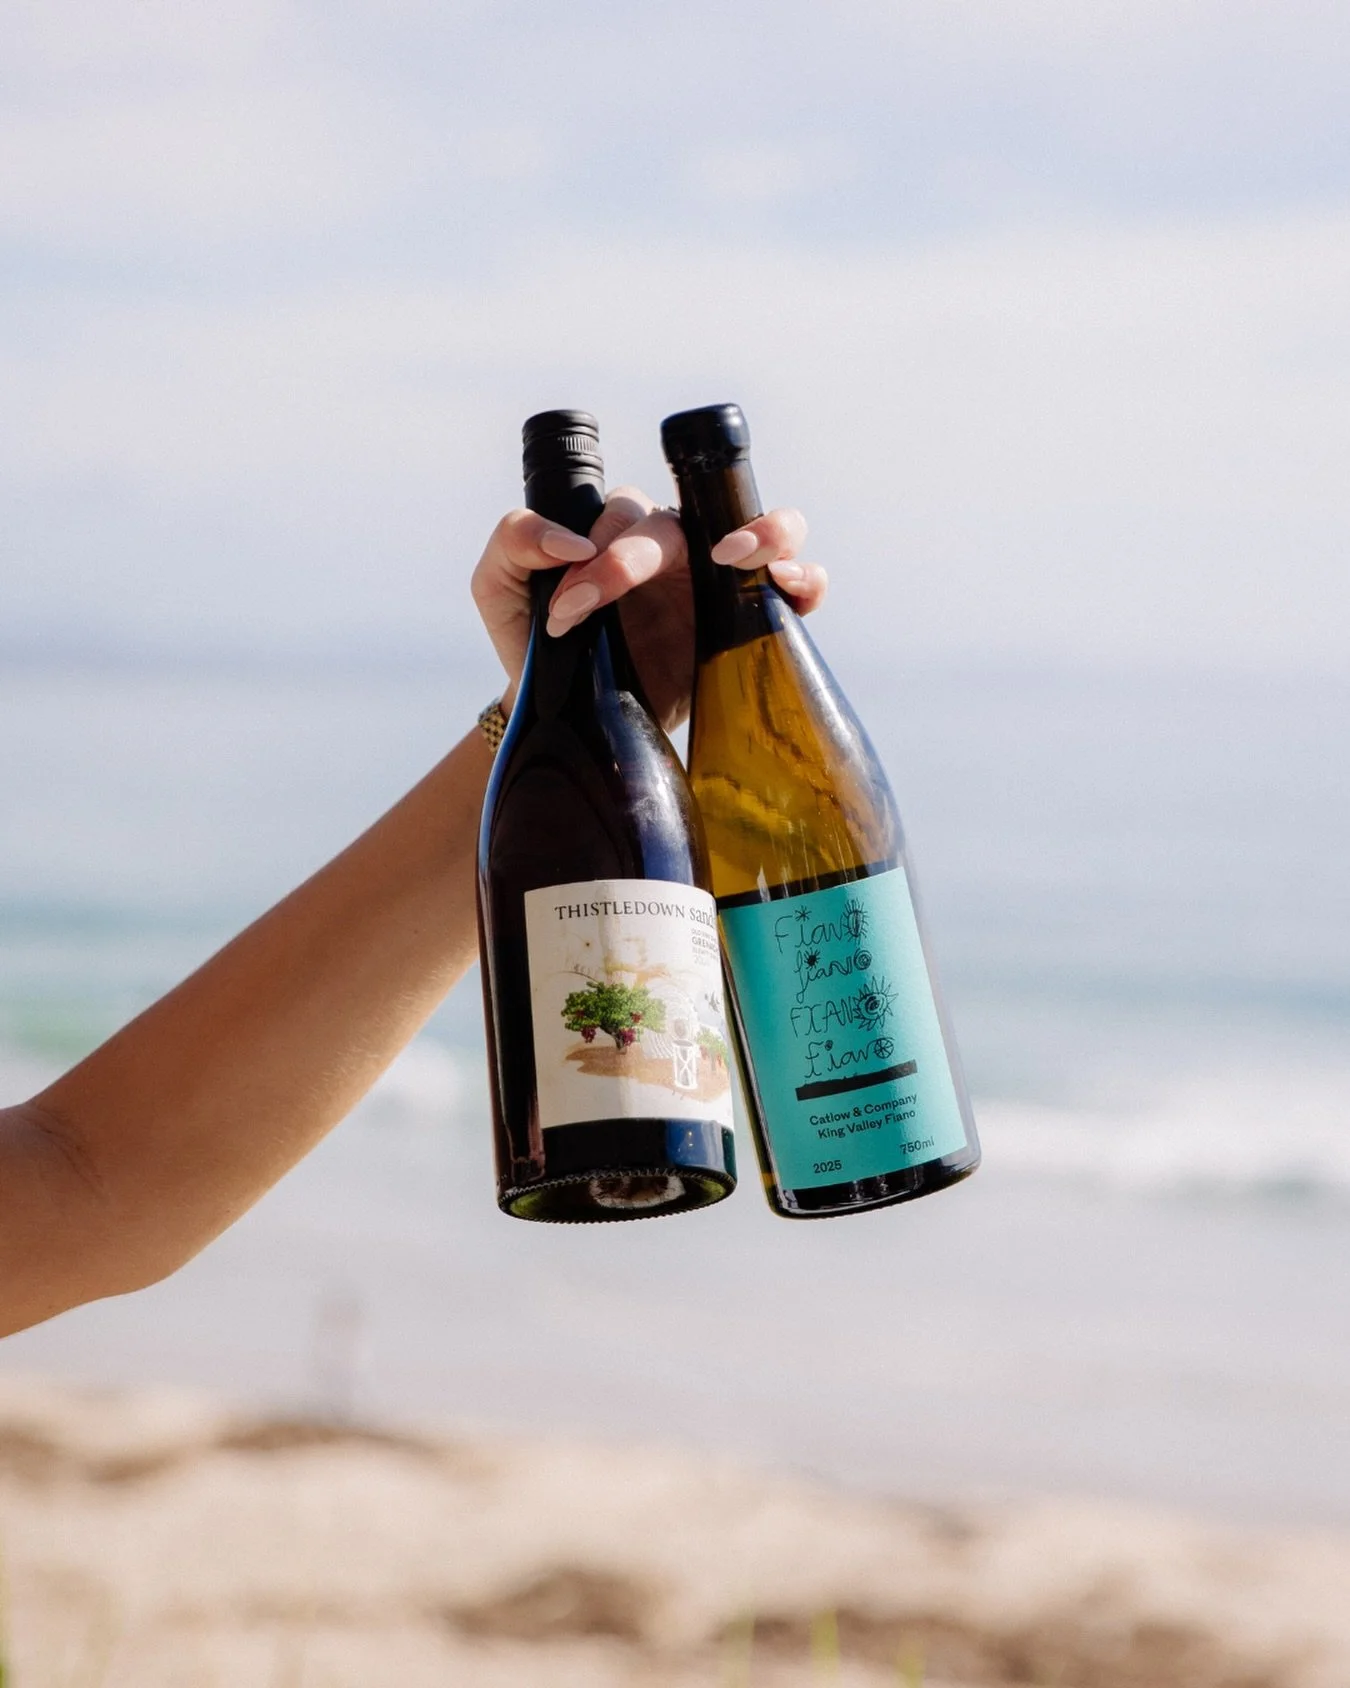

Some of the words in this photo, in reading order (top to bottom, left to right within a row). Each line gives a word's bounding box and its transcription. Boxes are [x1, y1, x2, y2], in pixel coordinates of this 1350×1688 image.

[554, 901, 685, 920] THISTLEDOWN
[809, 1111, 851, 1126] Catlow
[852, 1106, 863, 1118] &
[864, 1094, 918, 1115] Company
[818, 1127, 846, 1139] King
[846, 1119, 884, 1134] Valley
[885, 1109, 916, 1125] Fiano
[899, 1136, 936, 1155] 750ml
[813, 1160, 842, 1174] 2025
